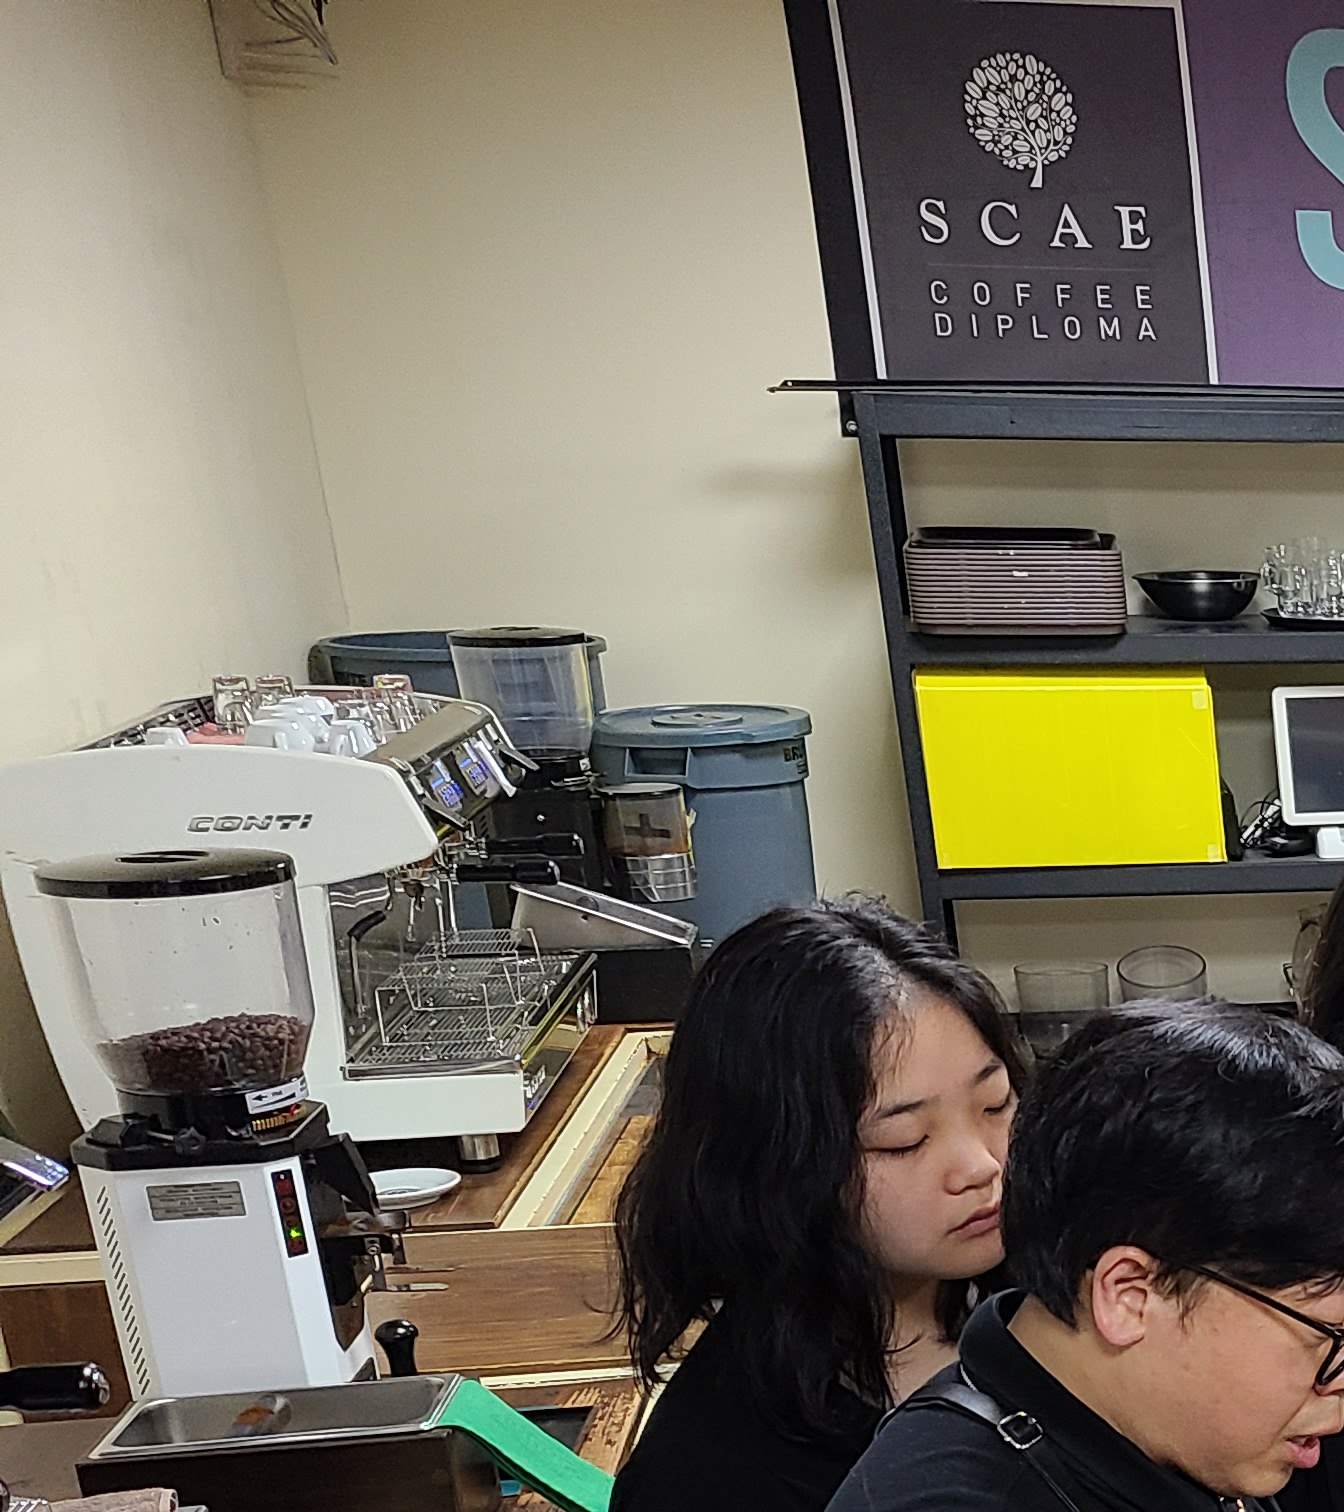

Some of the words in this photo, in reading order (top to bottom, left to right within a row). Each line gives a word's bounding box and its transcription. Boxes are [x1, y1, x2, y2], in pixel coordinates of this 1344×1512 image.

[917, 198, 1153, 251] SCAE
[930, 280, 1153, 310] COFFEE
[934, 313, 1157, 341] DIPLOMA
[187, 814, 313, 832] CONTI
